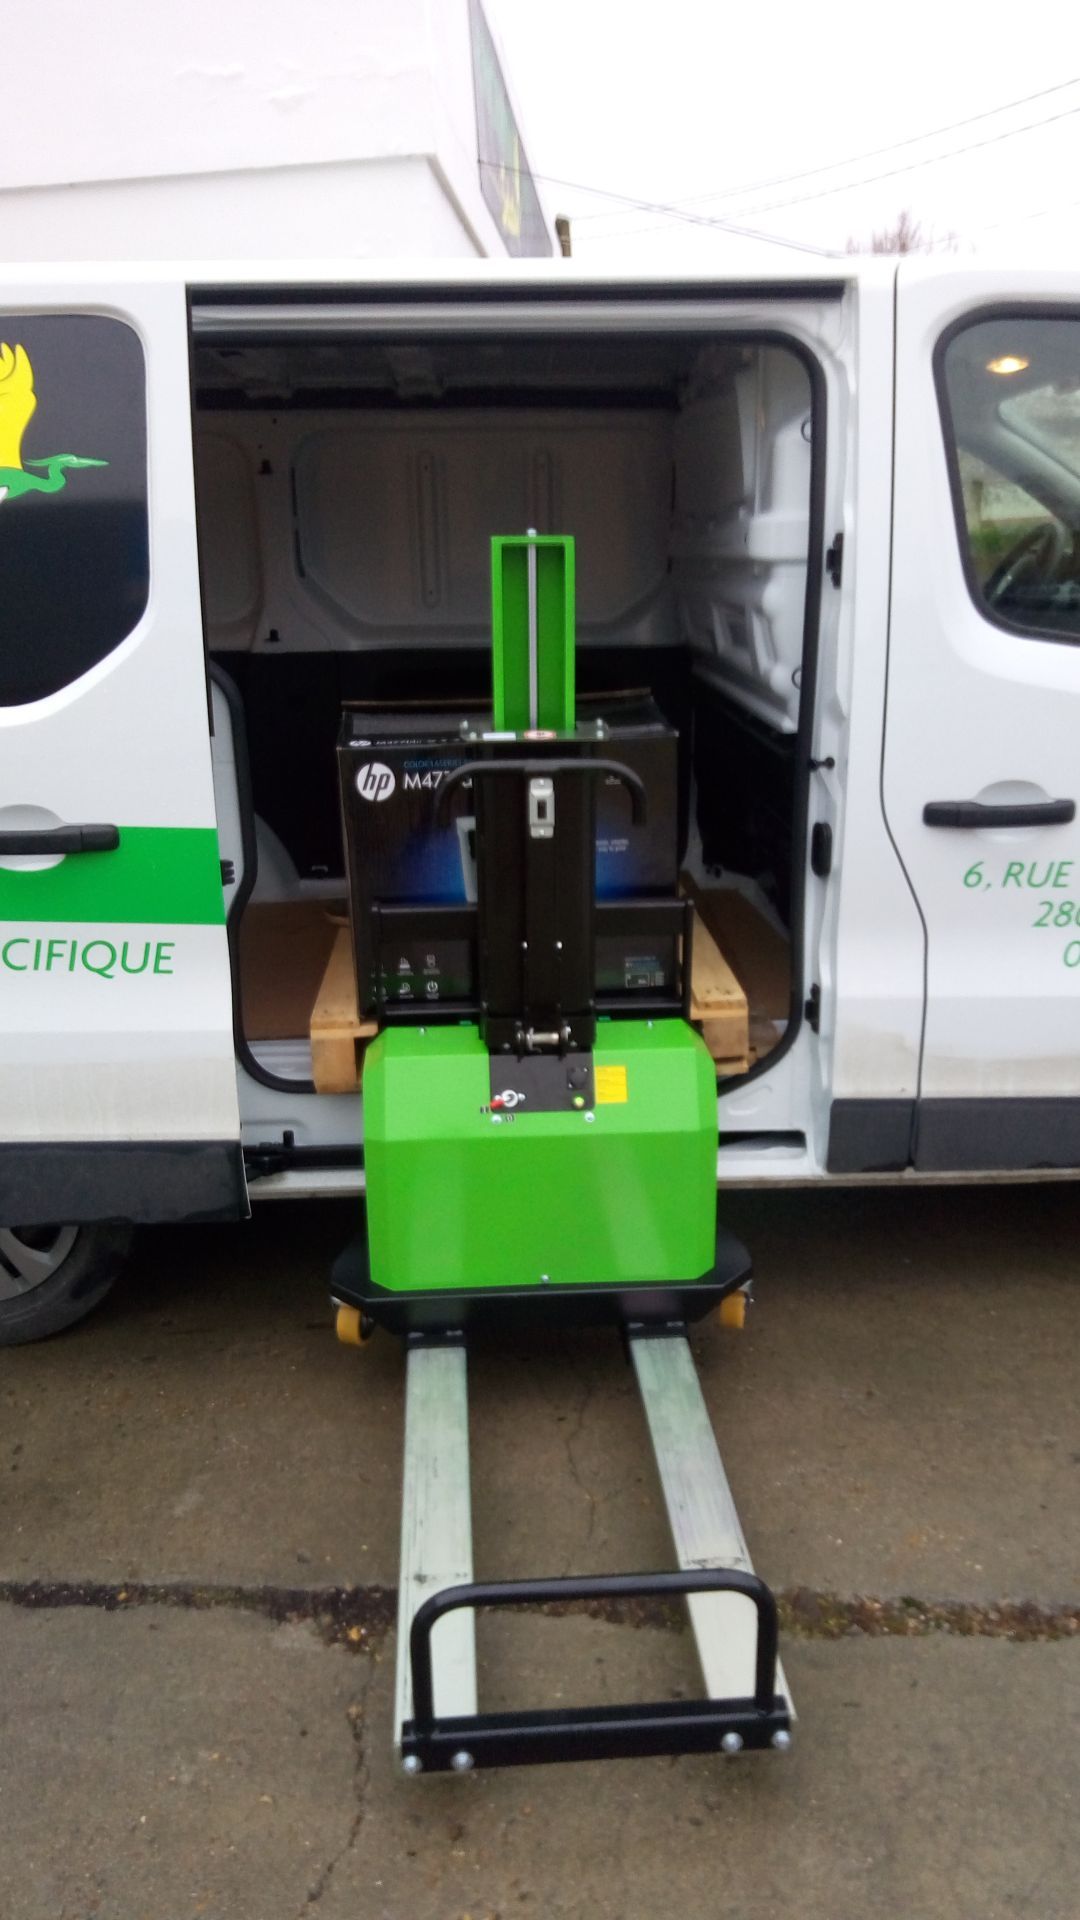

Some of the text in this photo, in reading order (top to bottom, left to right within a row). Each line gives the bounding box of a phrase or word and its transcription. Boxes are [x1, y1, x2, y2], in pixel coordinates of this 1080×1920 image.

[357, 762, 396, 801] hp
[963, 861, 1074, 891] 6, RUE
[1, 938, 175, 979] CIFIQUE
